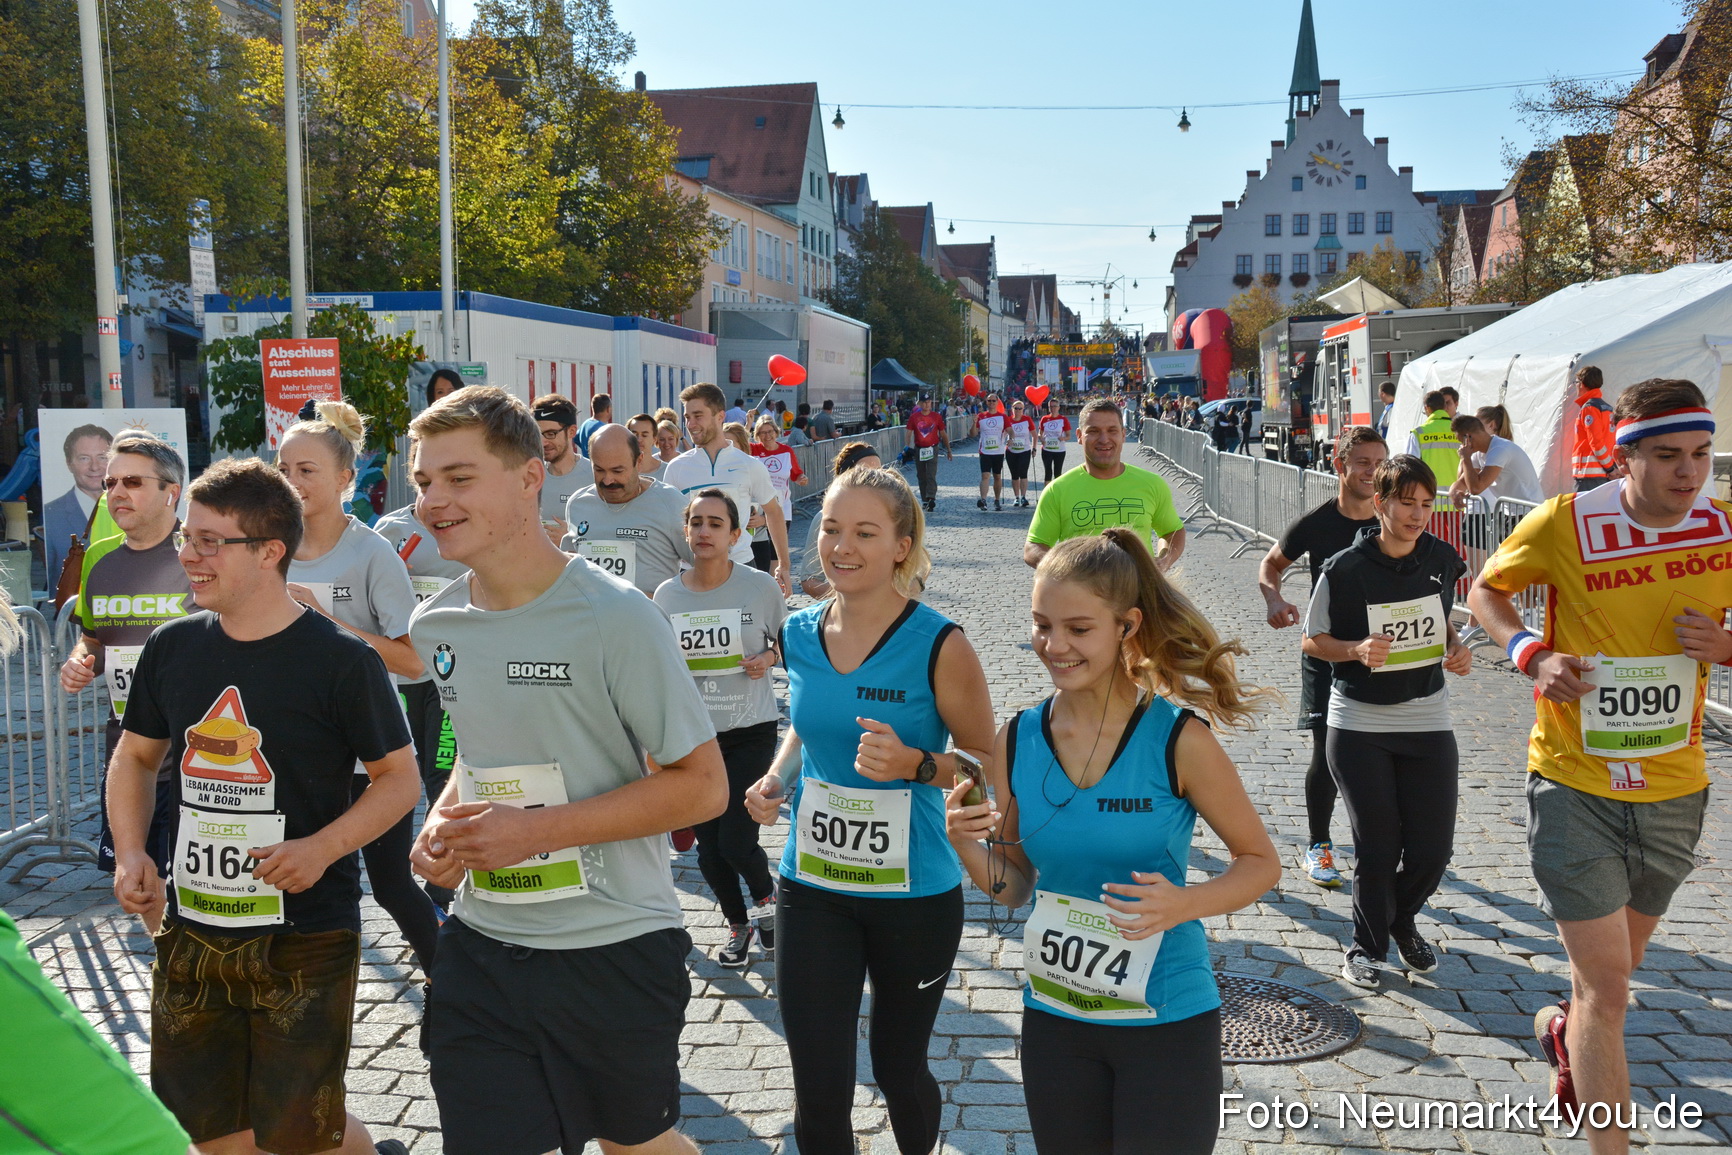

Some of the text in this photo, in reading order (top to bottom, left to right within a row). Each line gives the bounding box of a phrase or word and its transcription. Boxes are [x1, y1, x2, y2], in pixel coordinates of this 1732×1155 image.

[137, 344, 145, 360] 3
[269, 346, 334, 359] Abschluss
[269, 359, 291, 367] statt
[270, 367, 335, 378] Ausschluss!
[281, 382, 334, 392] Mehr Lehrer für
[279, 392, 307, 400] kleinere
[616, 527, 648, 537] BOCK
[591, 545, 618, 553] BOCK
[412, 580, 439, 590] BOCK
[1584, 564, 1656, 592] MAX
[92, 594, 188, 618] BOCK
[1391, 604, 1423, 617] BOCK
[114, 619, 124, 628] by
[126, 619, 150, 627] smart
[689, 615, 720, 625] BOCK
[1382, 616, 1435, 643] 5212
[680, 626, 731, 650] 5210
[507, 661, 571, 680] BOCK
[1615, 666, 1667, 678] BOCK
[702, 681, 720, 693] 19.
[857, 686, 906, 703] THULE
[1599, 684, 1681, 717] 5090
[1606, 718, 1666, 728] PARTL Neumarkt
[1620, 733, 1662, 748] Julian
[185, 778, 266, 796] LEBAKAASSEMME
[473, 779, 524, 796] BOCK
[198, 793, 241, 807] AN BORD
[829, 793, 874, 811] BOCK
[1096, 798, 1153, 813] THULE
[198, 821, 247, 836] BOCK
[811, 810, 890, 854] 5075
[185, 840, 262, 880] 5164
[817, 848, 873, 865] PARTL Neumarkt
[488, 871, 543, 889] Bastian
[824, 863, 875, 882] Hannah
[190, 879, 245, 893] PARTL Neumarkt
[193, 894, 256, 915] Alexander
[1067, 909, 1118, 934] BOCK
[1040, 929, 1132, 986] 5074
[1046, 970, 1107, 996] PARTL Neumarkt
[1067, 991, 1104, 1010] Alina
